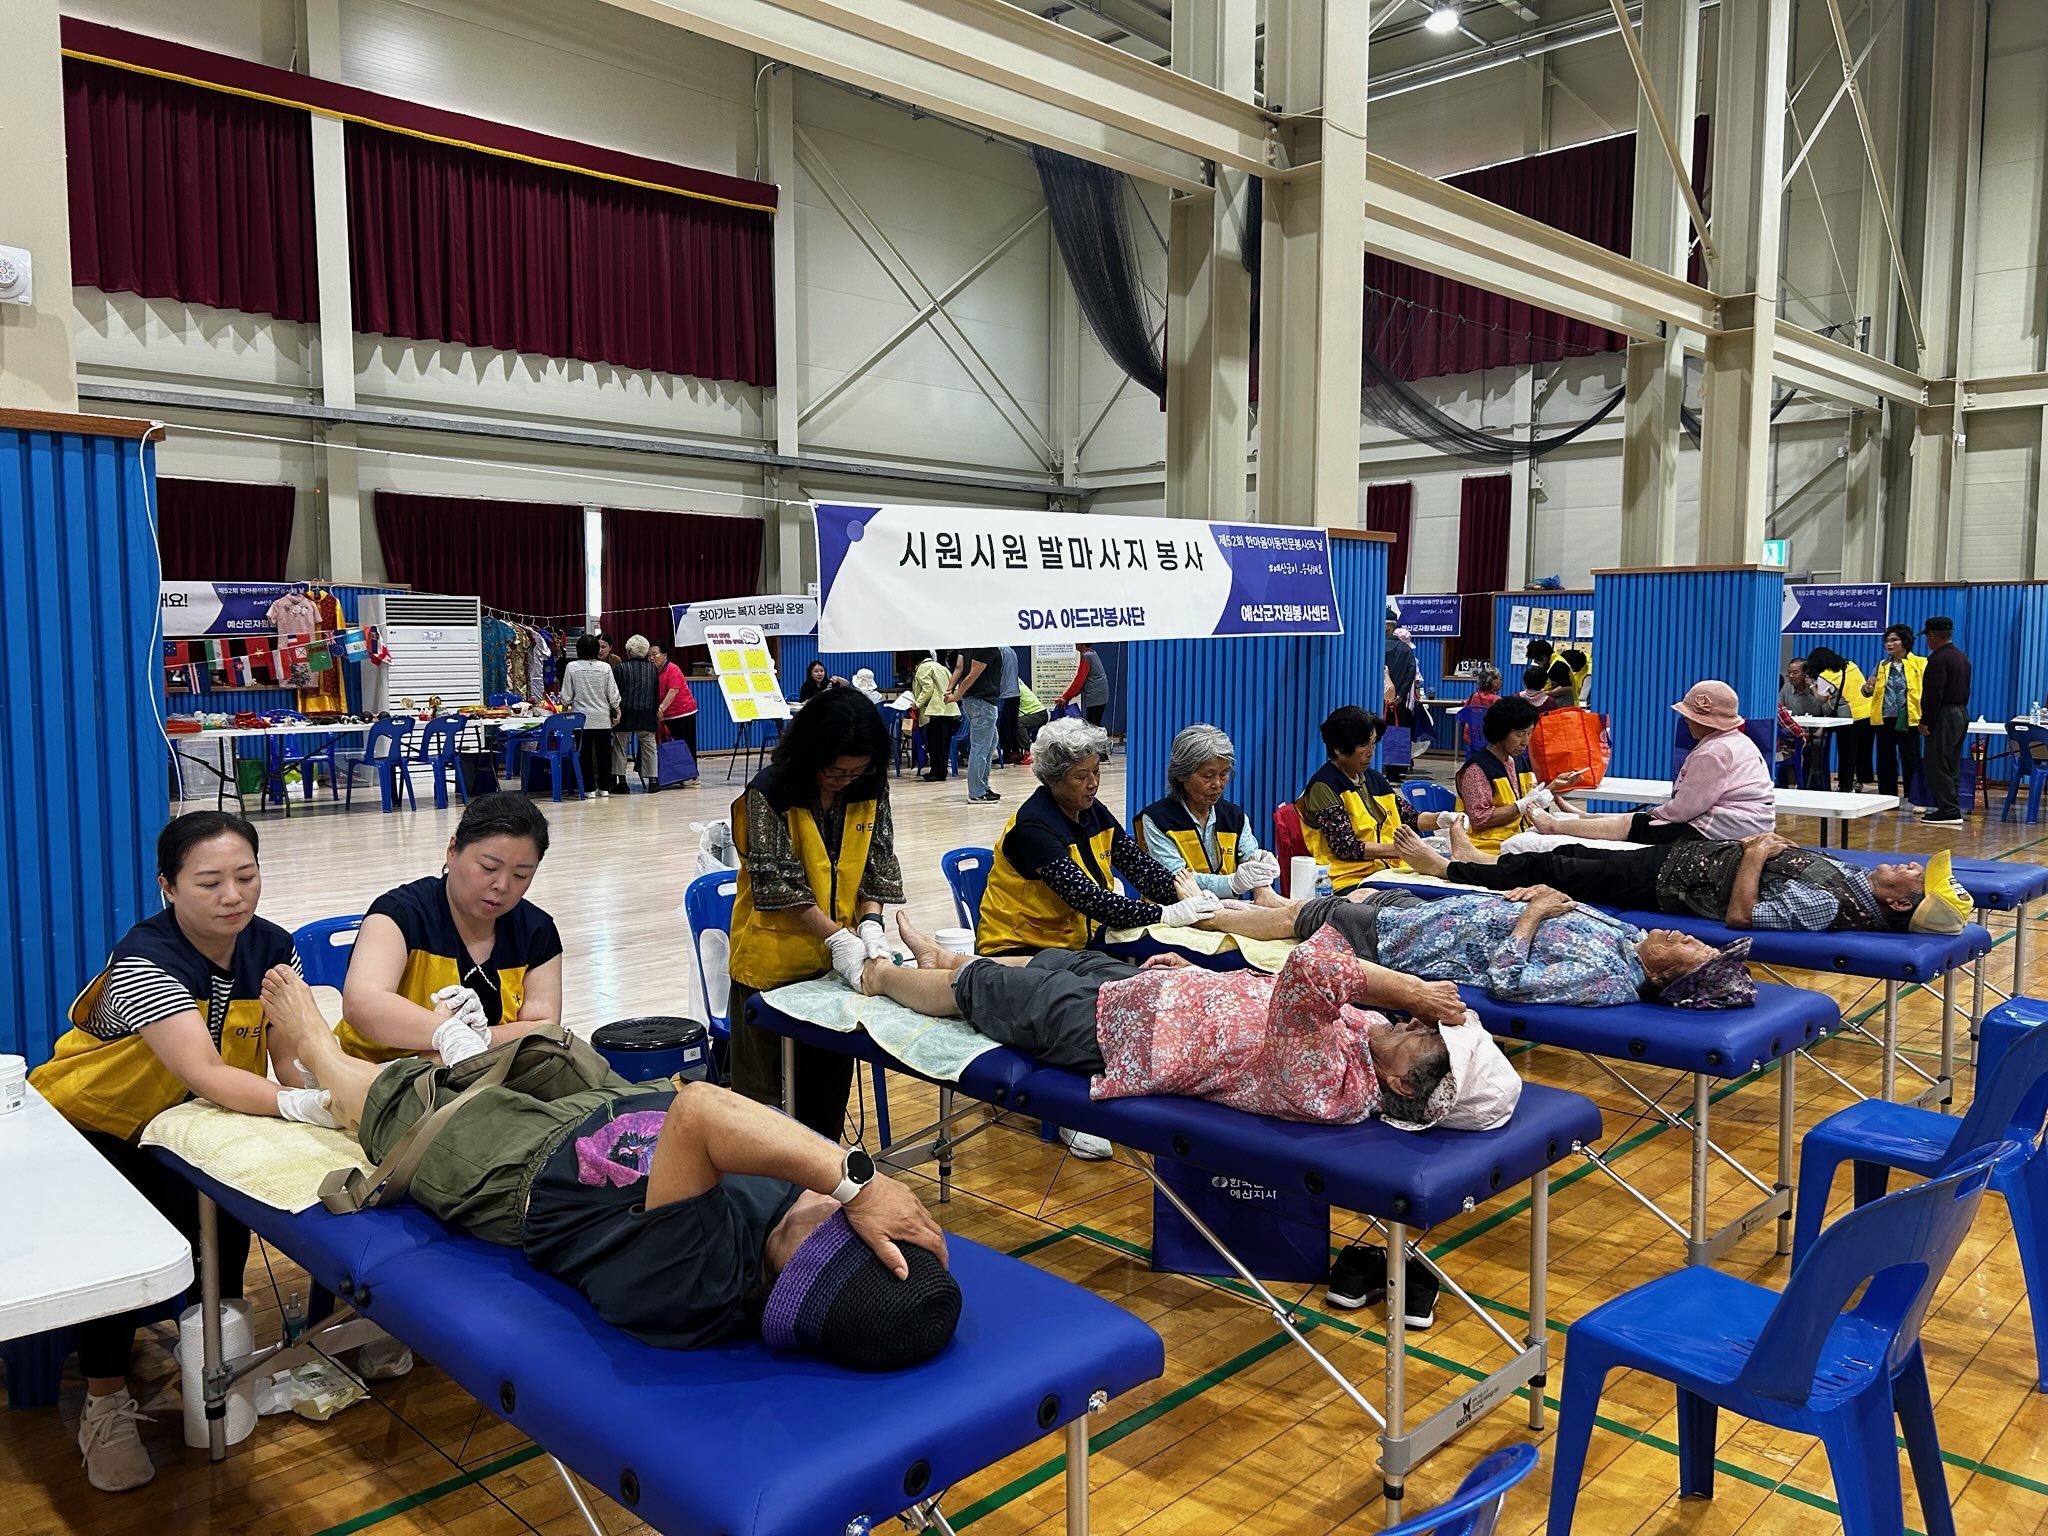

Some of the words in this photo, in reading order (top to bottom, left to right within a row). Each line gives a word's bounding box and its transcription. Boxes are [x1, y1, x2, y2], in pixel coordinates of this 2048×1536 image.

[899, 531, 1029, 570] 시원시원
[1038, 535, 1149, 571] 발마사지
[1155, 539, 1204, 572] 봉사
[1217, 533, 1245, 549] 제52회
[1315, 538, 1324, 552] 날
[698, 607, 737, 622] 찾아가는
[737, 604, 756, 617] 복지
[757, 602, 785, 616] 상담실
[785, 602, 804, 615] 운영
[1017, 608, 1058, 630] SDA
[1060, 606, 1146, 629] 아드라봉사단
[1240, 604, 1330, 622] 예산군자원봉사센터
[1801, 620, 1878, 629] 예산군자원봉사센터
[1460, 660, 1470, 671] 13
